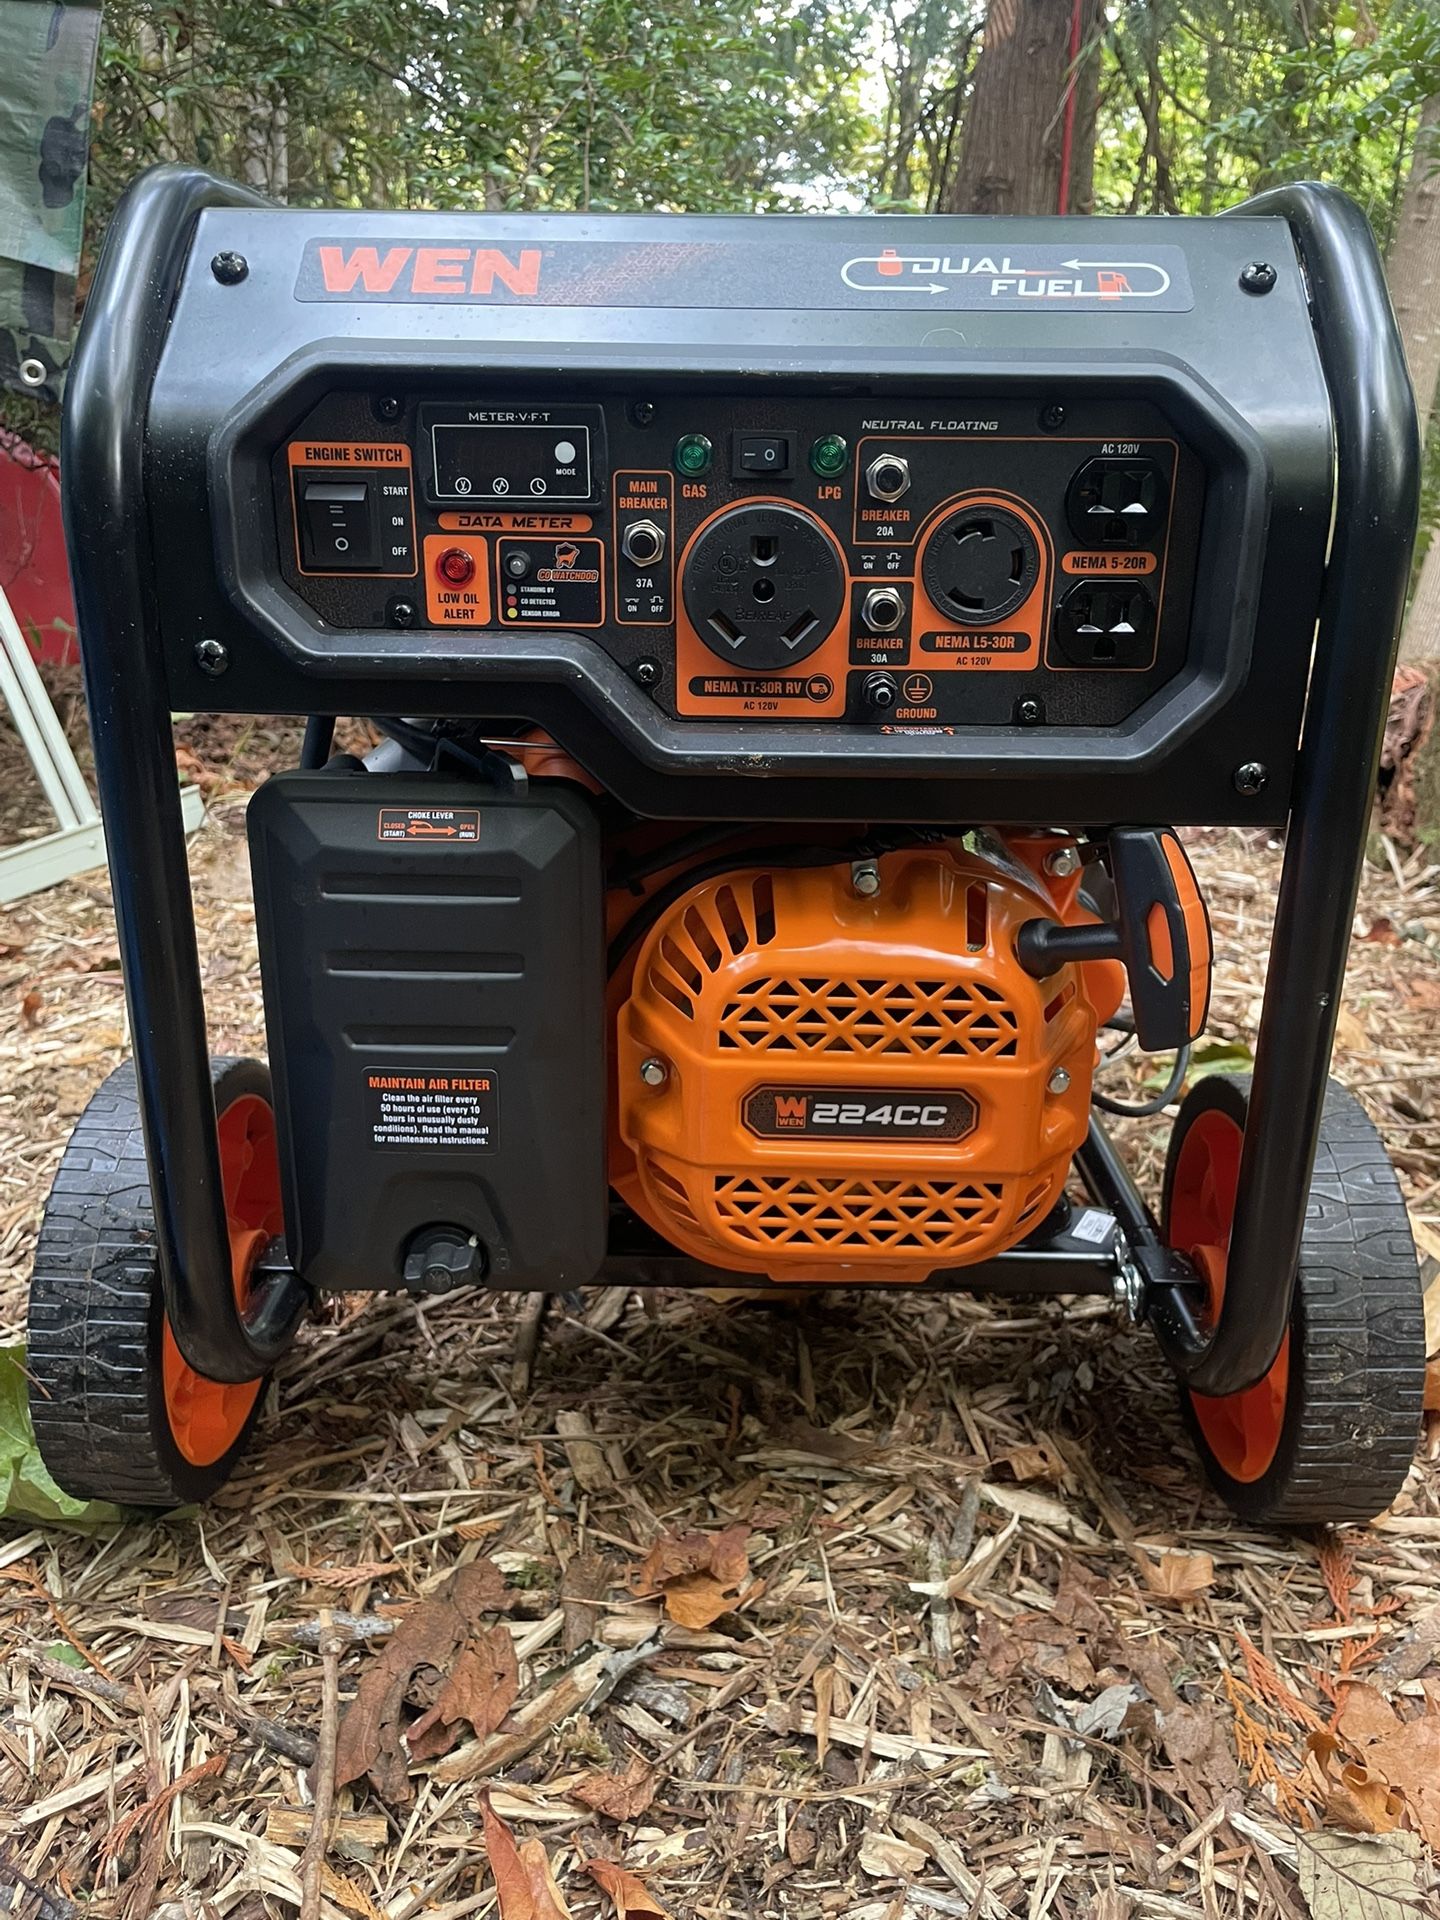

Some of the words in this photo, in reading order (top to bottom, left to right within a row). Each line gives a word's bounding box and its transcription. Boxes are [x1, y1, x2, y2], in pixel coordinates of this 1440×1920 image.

[319, 246, 542, 296] WEN
[911, 257, 1026, 275] DUAL
[990, 279, 1096, 296] FUEL
[862, 420, 924, 430] NEUTRAL
[930, 420, 998, 430] FLOATING
[1101, 443, 1114, 454] AC
[1116, 443, 1139, 454] 120V
[305, 447, 350, 461] ENGINE
[354, 448, 402, 462] SWITCH
[556, 468, 576, 476] MODE
[383, 486, 409, 496] START
[629, 481, 657, 493] MAIN
[682, 484, 707, 498] GAS
[817, 486, 841, 500] LPG
[619, 498, 668, 509] BREAKER
[861, 509, 910, 521] BREAKER
[392, 517, 404, 526] ON
[458, 516, 503, 528] DATA
[512, 517, 573, 528] METER
[876, 526, 893, 536] 20A
[392, 547, 407, 556] OFF
[863, 561, 873, 570] ON
[887, 562, 899, 570] OFF
[1072, 556, 1107, 569] NEMA
[1111, 557, 1147, 569] 5-20R
[539, 570, 551, 580] CO
[552, 570, 597, 581] WATCHDOG
[636, 578, 653, 588] 37A
[438, 592, 463, 604] LOW
[465, 593, 480, 604] OIL
[443, 608, 476, 620] ALERT
[651, 605, 664, 613] OFF
[856, 637, 903, 649] BREAKER
[935, 636, 970, 648] NEMA
[973, 636, 1015, 649] L5-30R
[871, 653, 888, 663] 30A
[956, 656, 969, 665] AC
[971, 656, 992, 666] 120V
[704, 680, 738, 693] NEMA
[743, 681, 782, 694] TT-30R
[784, 682, 802, 694] RV
[743, 701, 755, 710] AC
[758, 702, 778, 711] 120V
[895, 708, 937, 719] GROUND
[408, 811, 430, 819] CHOKE
[383, 830, 405, 838] (START)
[459, 830, 475, 839] (RUN)
[368, 1077, 425, 1089] MAINTAIN
[429, 1078, 448, 1090] AIR
[452, 1079, 490, 1090] FILTER
[382, 1093, 405, 1102] Clean
[407, 1094, 419, 1102] the
[422, 1095, 433, 1103] air
[435, 1095, 453, 1103] filter
[455, 1096, 477, 1105] every
[380, 1104, 391, 1112] 50
[393, 1104, 415, 1112] hours
[417, 1105, 425, 1113] of
[443, 1105, 468, 1115] (every
[811, 1103, 948, 1126] 224CC
[383, 1114, 405, 1122] hours
[407, 1115, 415, 1123] in
[417, 1115, 455, 1125] unusually
[457, 1116, 479, 1125] dusty
[778, 1118, 804, 1126] WEN
[373, 1124, 420, 1134] conditions).
[422, 1125, 443, 1134] Read
[445, 1126, 457, 1134] the
[459, 1126, 489, 1135] manual
[374, 1134, 386, 1143] for
[387, 1135, 438, 1144] maintenance
[440, 1136, 489, 1145] instructions.
